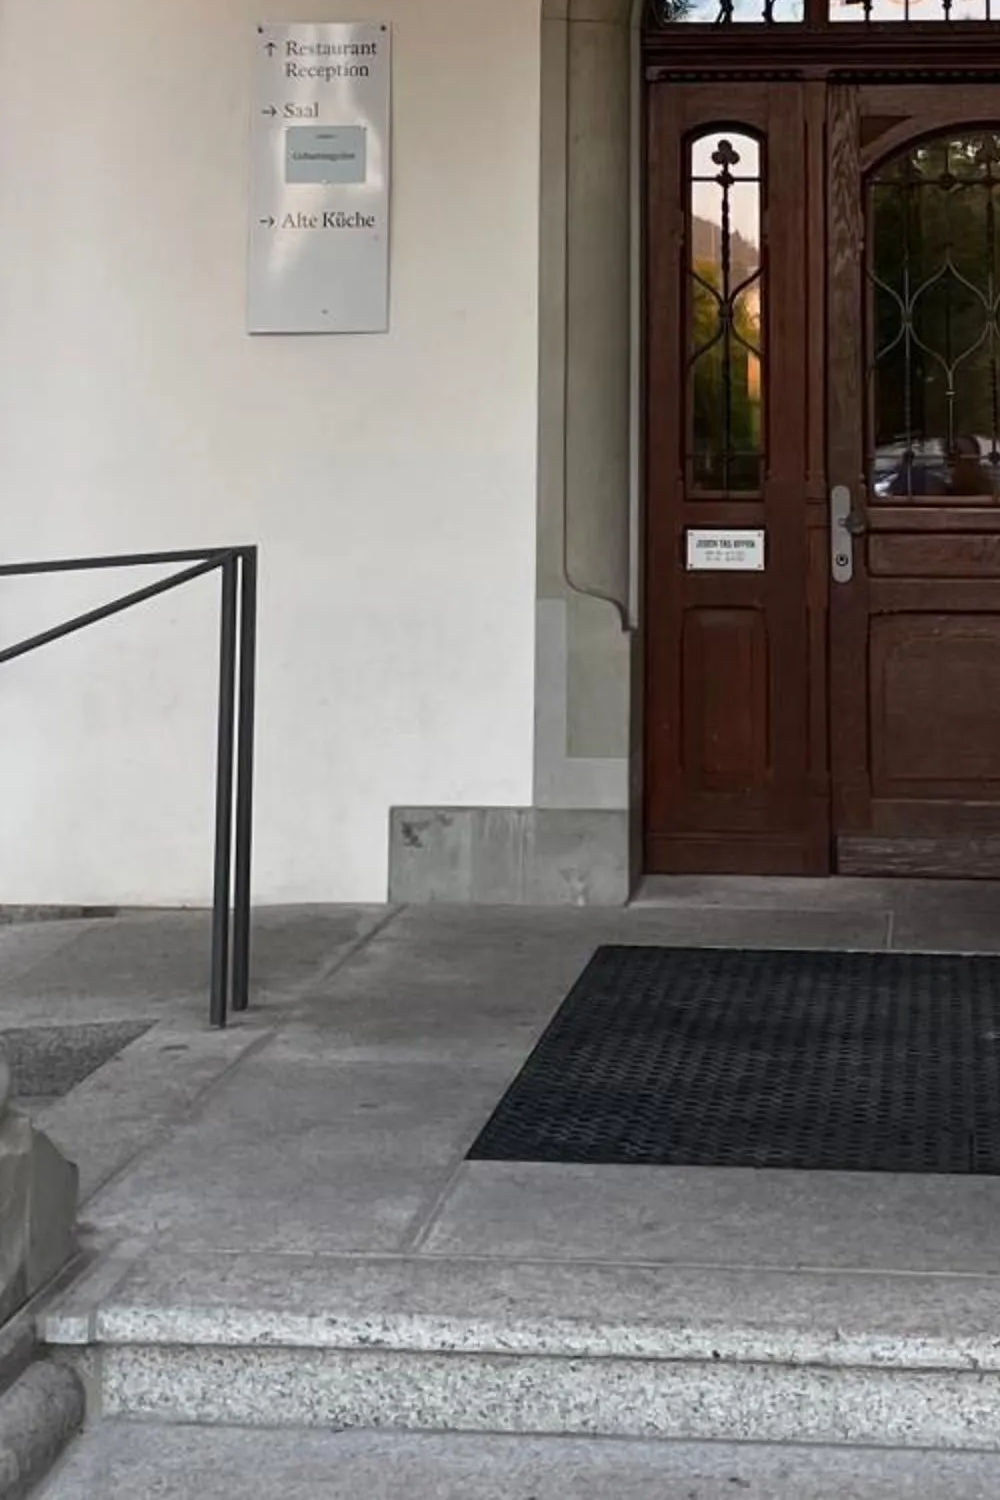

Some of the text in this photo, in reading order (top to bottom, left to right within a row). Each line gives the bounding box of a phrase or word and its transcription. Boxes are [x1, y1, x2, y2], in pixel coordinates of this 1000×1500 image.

[286, 40, 377, 56] Restaurant
[286, 63, 369, 82] Reception
[283, 101, 319, 118] Saal
[281, 211, 375, 228] Alte Küche
